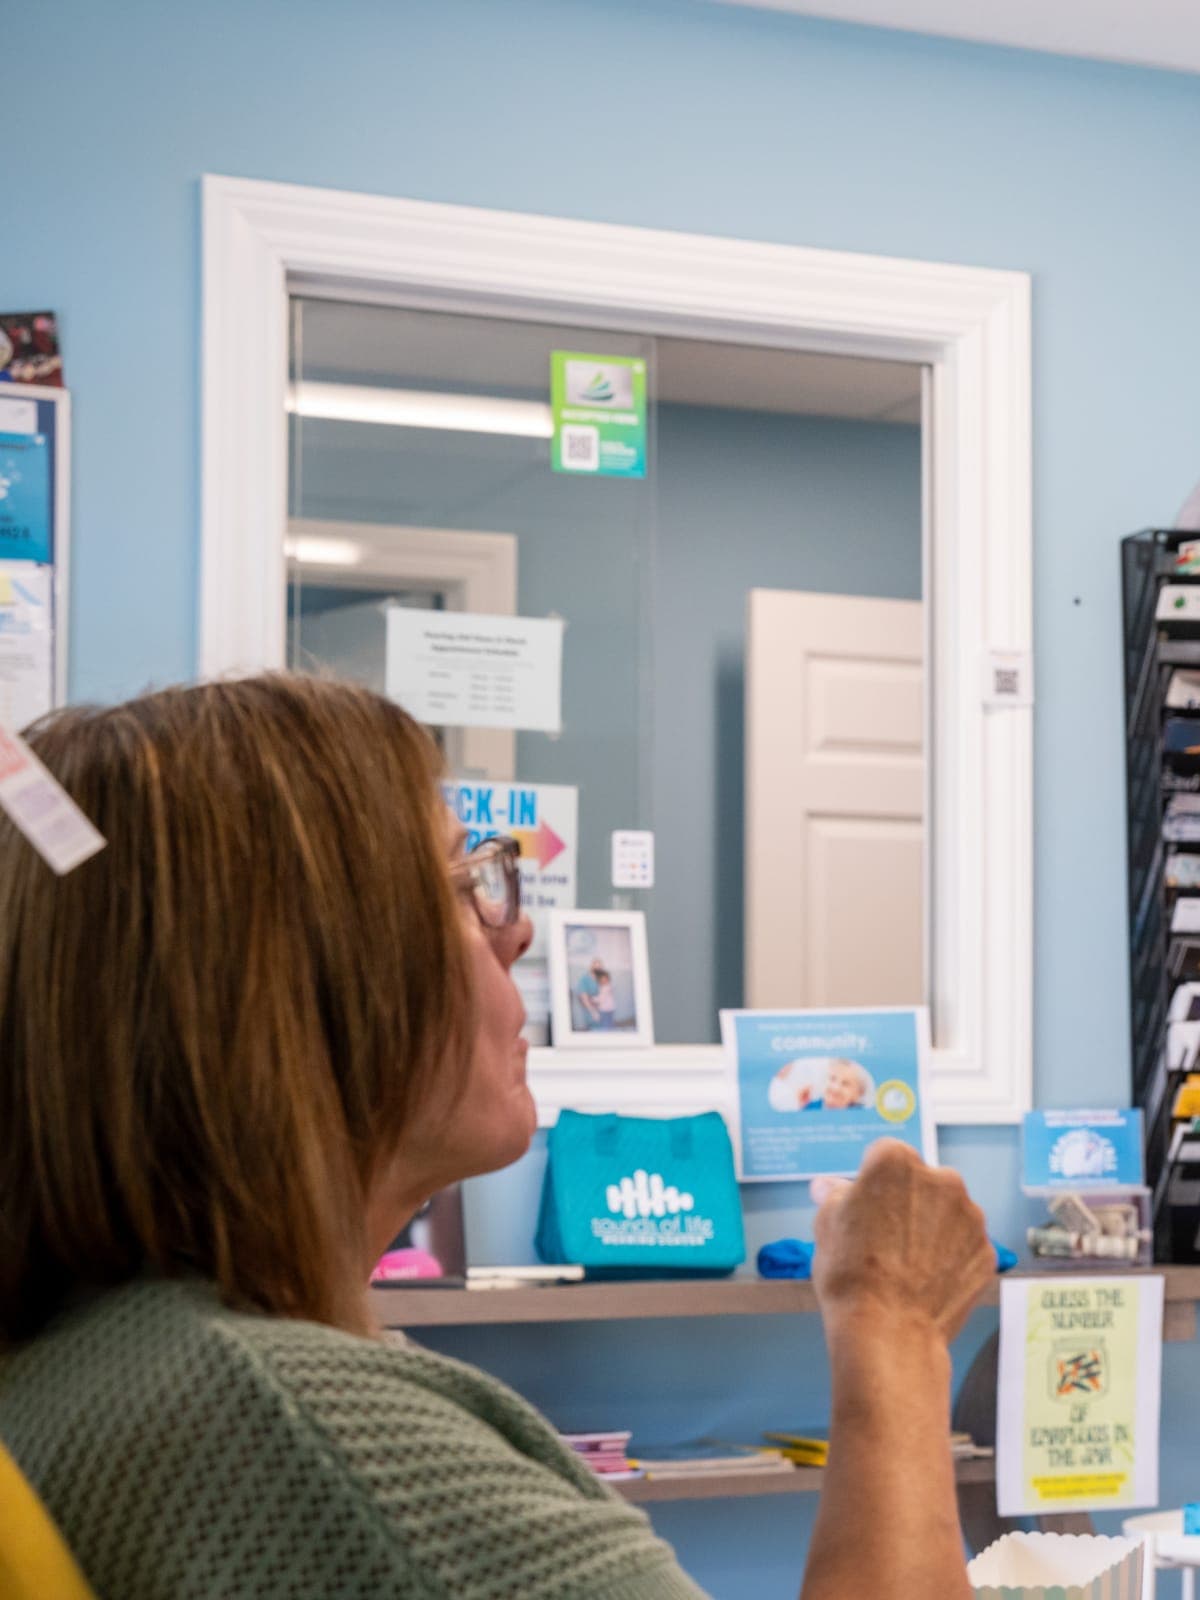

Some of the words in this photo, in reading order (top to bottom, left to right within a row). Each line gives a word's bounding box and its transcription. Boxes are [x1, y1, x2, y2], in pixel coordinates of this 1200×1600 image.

[591, 1217, 656, 1236] sounds
[660, 1215, 682, 1234] of
[685, 1215, 714, 1239] life
[1041, 1289, 1091, 1309] GUESS
[1095, 1288, 1124, 1307] THE
[1050, 1310, 1114, 1329] NUMBER
[1070, 1404, 1087, 1423] OF
[1030, 1425, 1108, 1447] EARPLUGS
[1114, 1425, 1129, 1443] IN
[1047, 1449, 1075, 1467] THE
[1081, 1448, 1112, 1466] JAR
